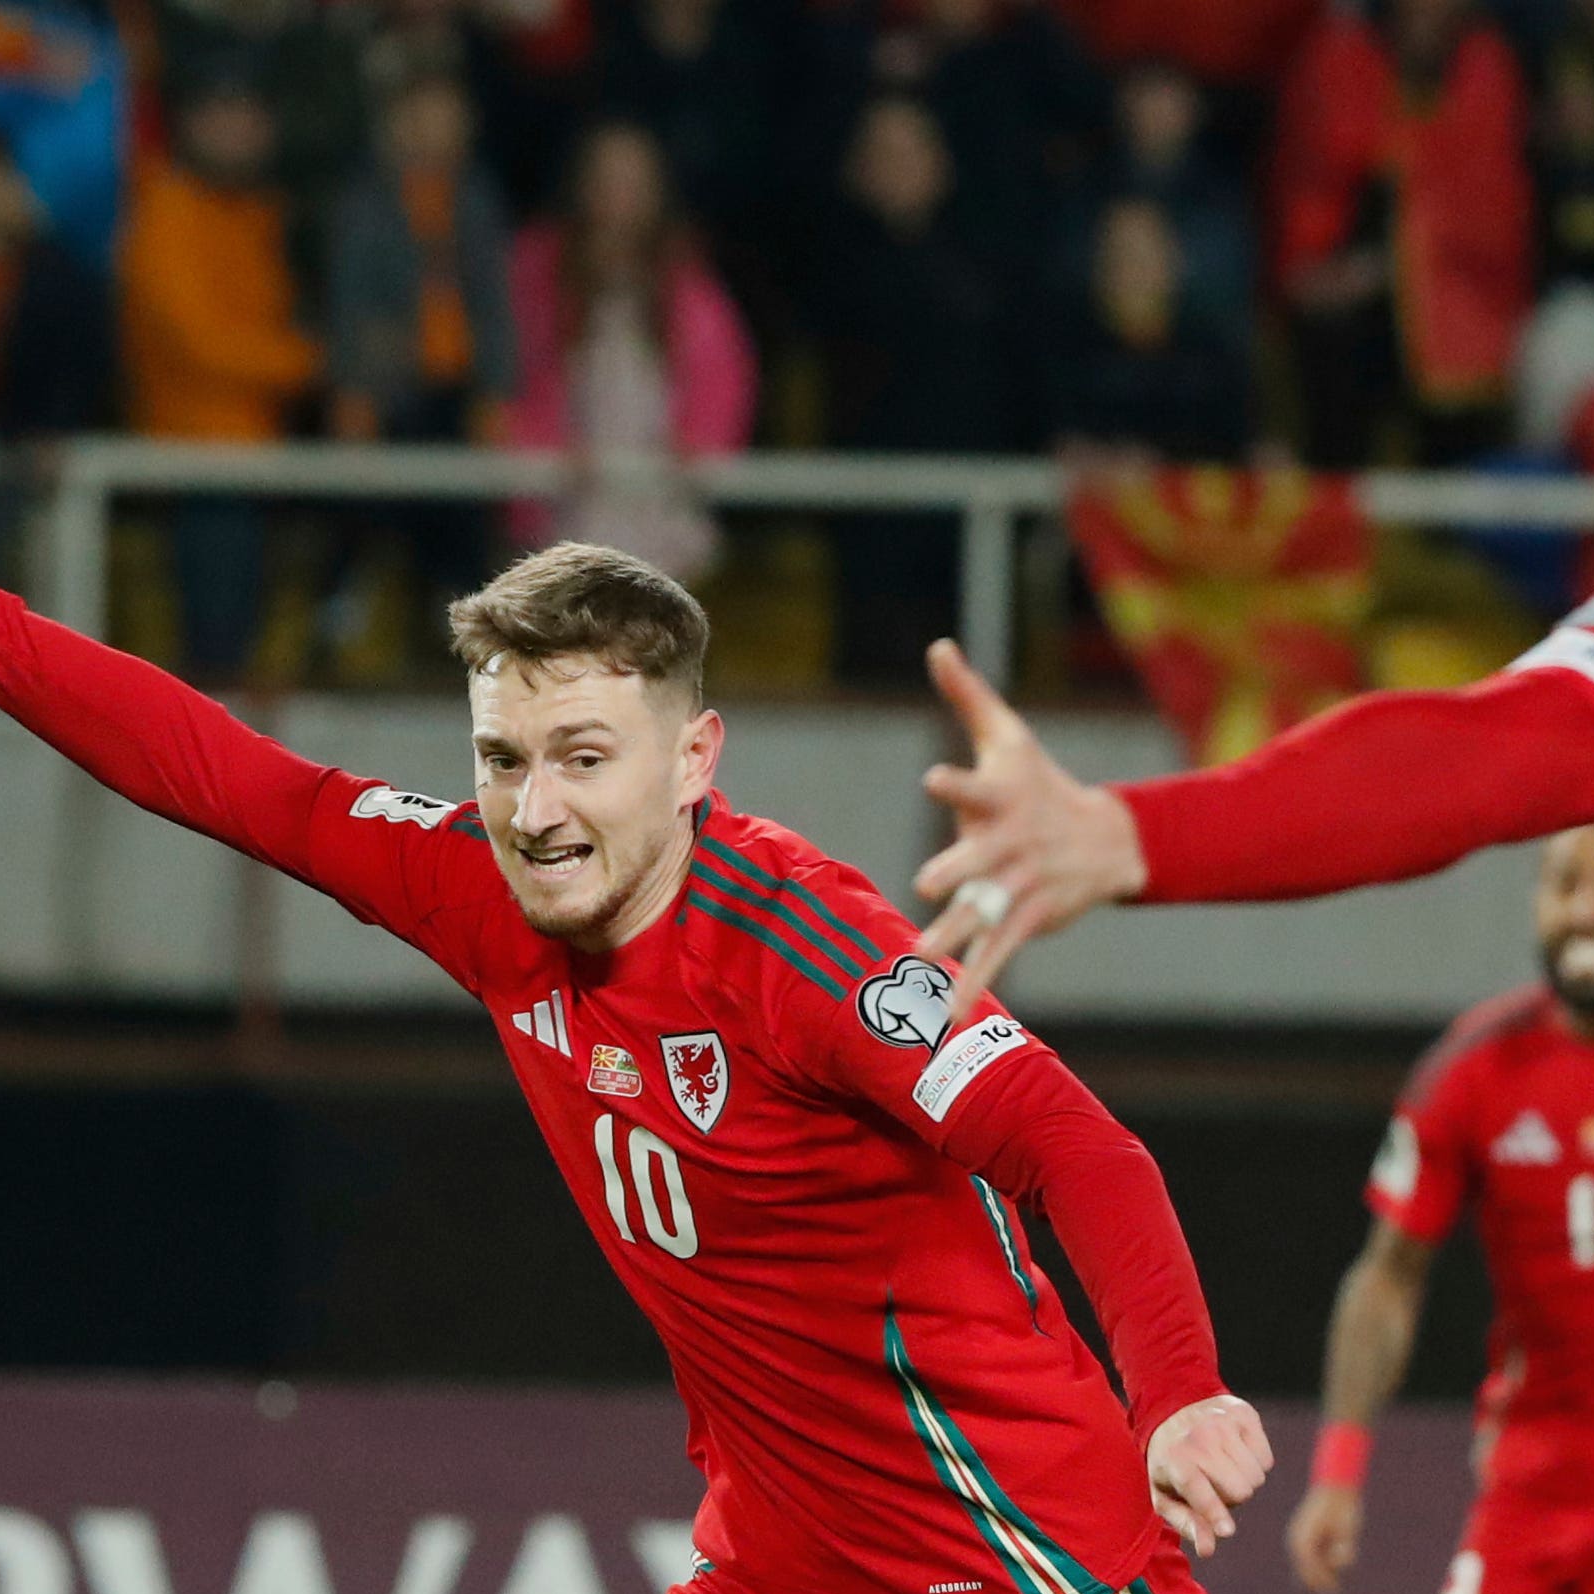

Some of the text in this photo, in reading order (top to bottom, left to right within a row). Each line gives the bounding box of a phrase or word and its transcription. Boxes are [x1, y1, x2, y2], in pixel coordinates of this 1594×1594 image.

[923, 1040, 986, 1107] FOUNDATION
[595, 1113, 699, 1260] 10
[929, 1581, 983, 1594] AEROREADY
